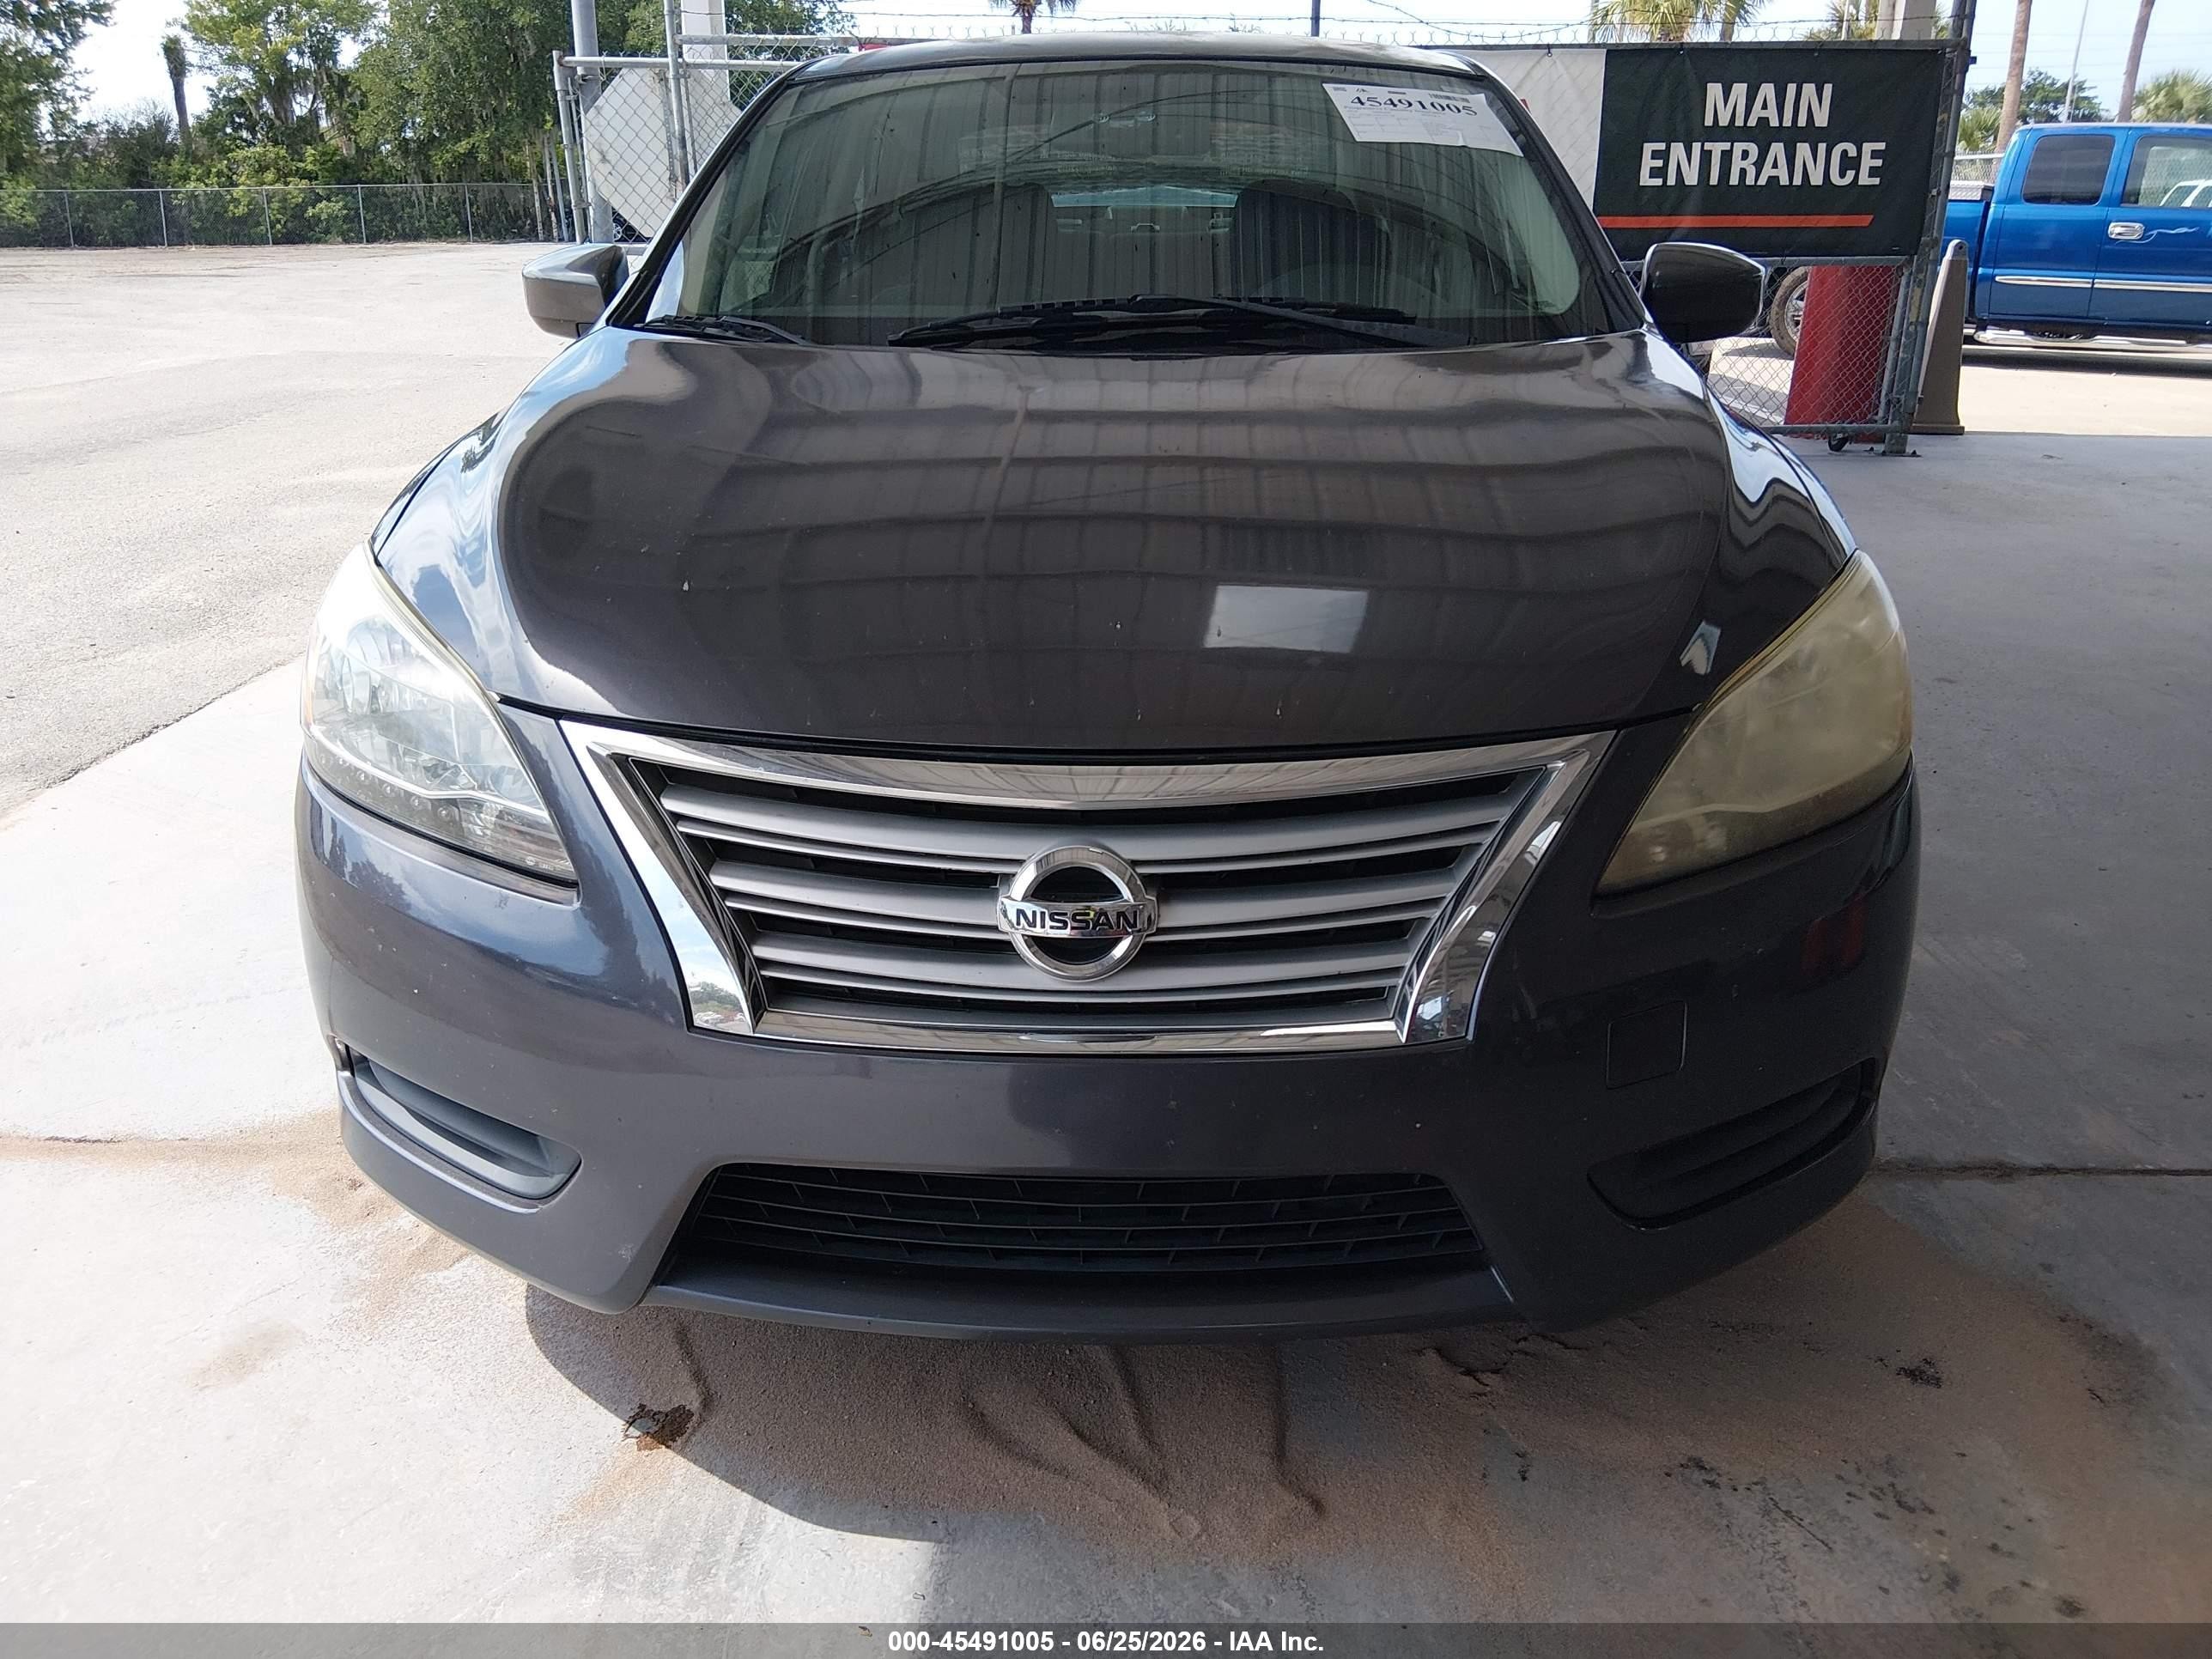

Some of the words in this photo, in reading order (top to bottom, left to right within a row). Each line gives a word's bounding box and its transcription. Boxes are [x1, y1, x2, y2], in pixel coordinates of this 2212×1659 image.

[1351, 96, 1478, 117] 45491005
[1704, 82, 1833, 127] MAIN
[1638, 142, 1887, 186] ENTRANCE
[1015, 908, 1139, 931] NISSAN
